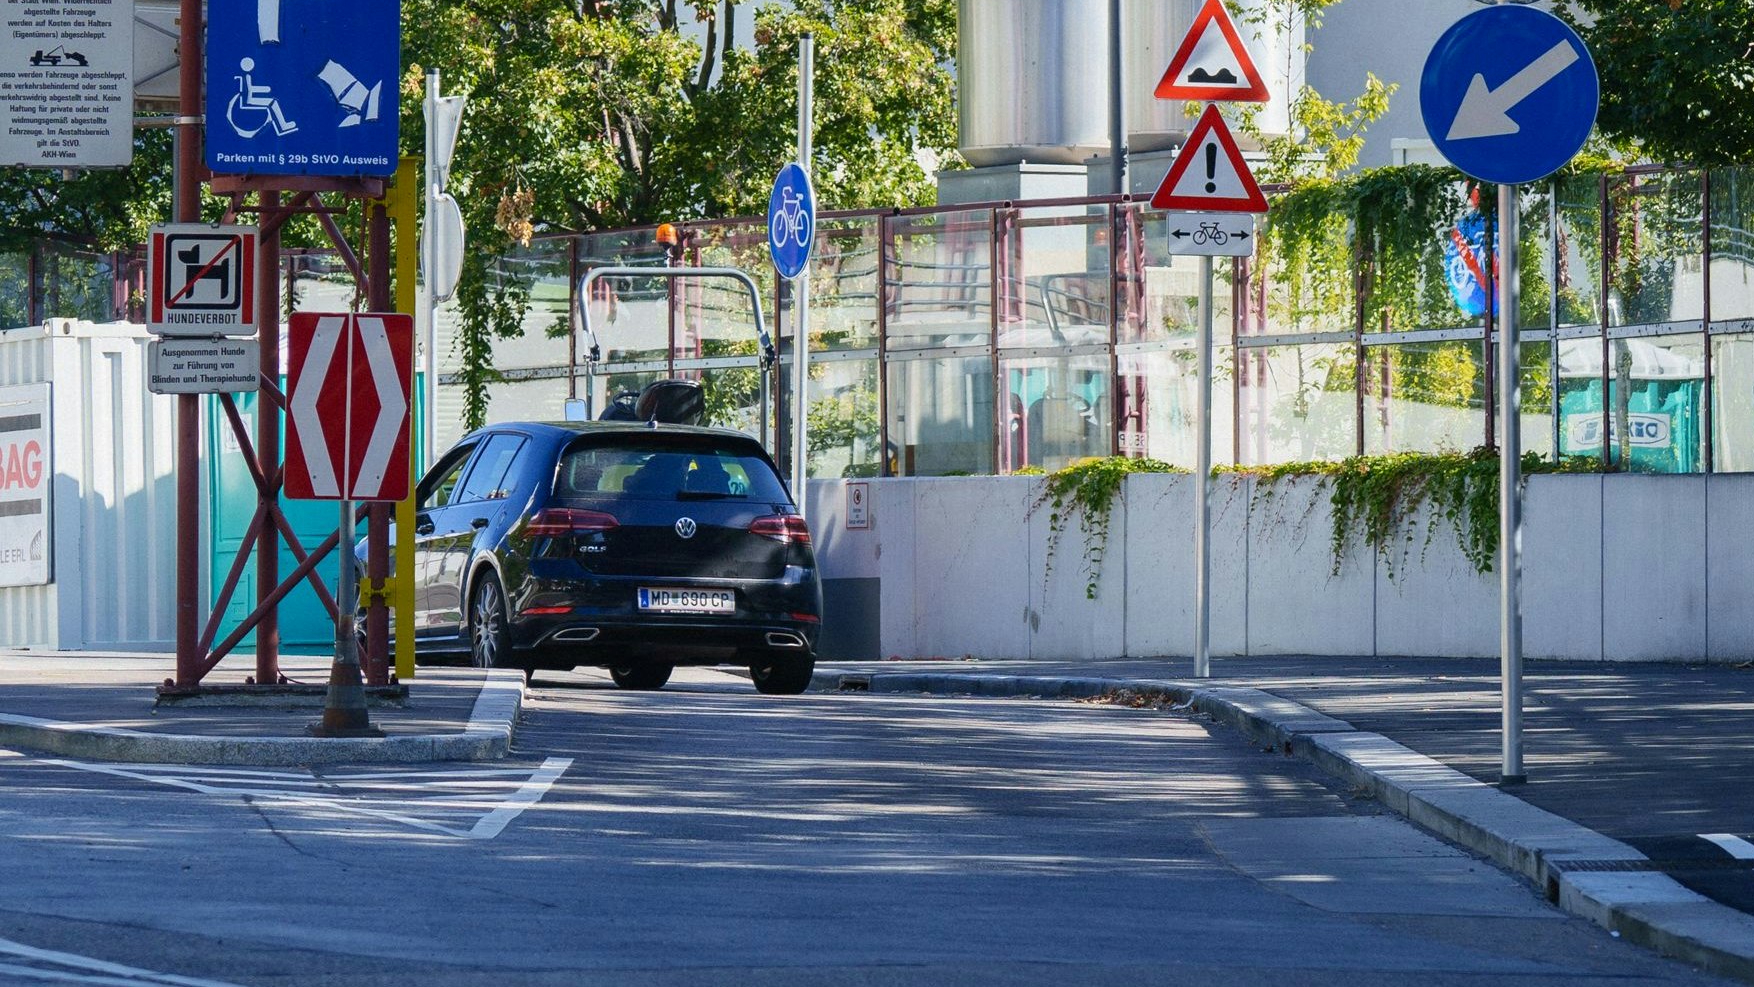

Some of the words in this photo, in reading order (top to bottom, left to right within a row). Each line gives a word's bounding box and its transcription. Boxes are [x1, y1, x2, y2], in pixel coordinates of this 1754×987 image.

[23, 7, 61, 17] abgestellte
[62, 7, 97, 18] Fahrzeuge
[7, 18, 33, 27] werden
[34, 18, 47, 27] auf
[47, 18, 72, 28] Kosten
[73, 18, 86, 27] des
[87, 19, 113, 28] Halters
[12, 30, 59, 40] (Eigentümers)
[60, 30, 107, 40] abgeschleppt.
[17, 70, 44, 79] werden
[45, 70, 79, 81] Fahrzeuge
[80, 70, 128, 81] abgeschleppt,
[1, 81, 13, 90] die
[13, 81, 80, 91] verkehrsbehindernd
[81, 82, 97, 91] oder
[98, 83, 118, 91] sonst
[48, 93, 82, 103] abgestellt
[83, 93, 101, 102] sind.
[102, 93, 122, 102] Keine
[9, 104, 37, 115] Haftung
[38, 104, 49, 113] für
[49, 104, 74, 115] private
[75, 105, 91, 114] oder
[92, 105, 110, 114] nicht
[11, 115, 69, 126] widmungsgemäß
[70, 116, 108, 126] abgestellte
[8, 126, 45, 137] Fahrzeuge.
[46, 127, 57, 136] Im
[57, 127, 111, 136] Anstaltsbereich
[36, 138, 48, 149] gilt
[49, 138, 61, 147] die
[40, 150, 77, 159] AKH-Wien
[216, 152, 255, 163] Parken
[258, 153, 276, 163] mit
[278, 153, 285, 165] §
[288, 154, 309, 164] 29b
[311, 154, 339, 164] StVO
[342, 155, 389, 165] Ausweis
[167, 313, 238, 325] HUNDEVERBOT
[161, 348, 219, 359] Ausgenommen
[220, 346, 246, 356] Hunde
[187, 360, 218, 372] Führung
[220, 362, 235, 370] von
[151, 374, 181, 384] Blinden
[182, 374, 198, 384] und
[199, 373, 256, 385] Therapiehunde
[0, 439, 43, 490] AG
[579, 545, 607, 553] GOLF
[651, 590, 670, 607] MD
[681, 591, 708, 608] 690
[711, 591, 729, 608] CP
